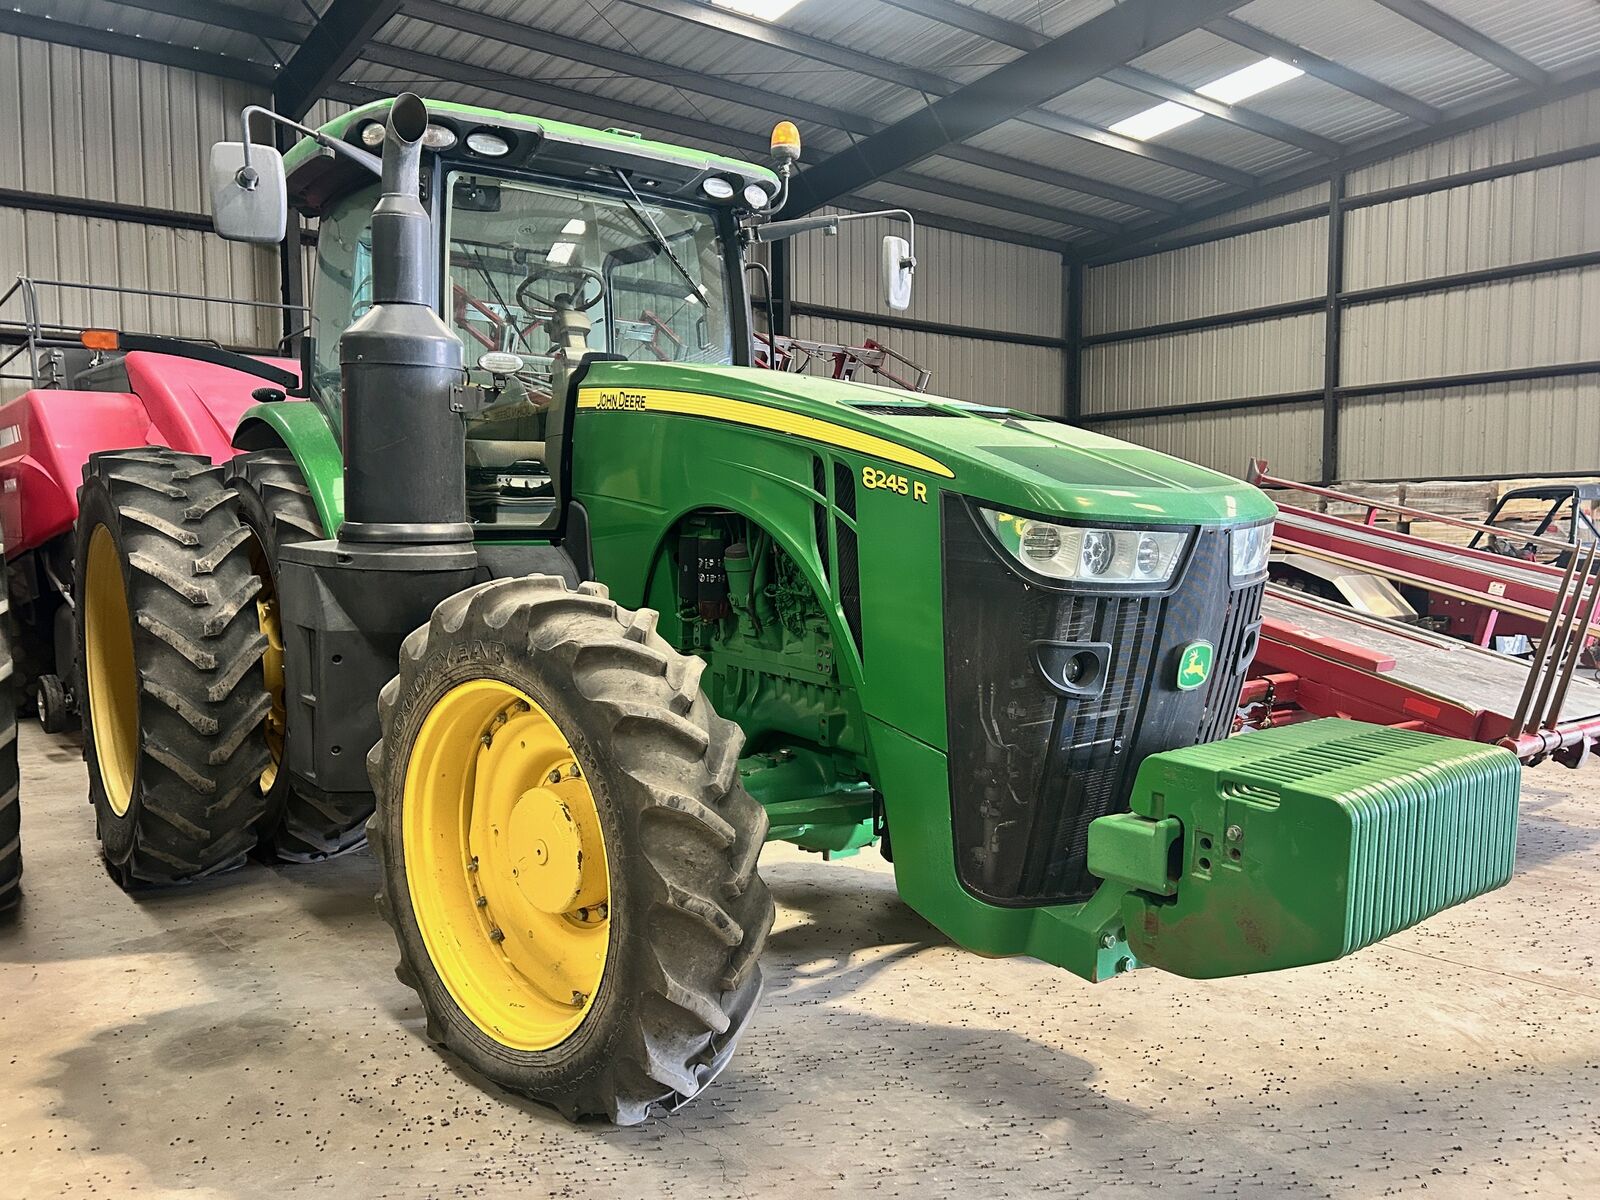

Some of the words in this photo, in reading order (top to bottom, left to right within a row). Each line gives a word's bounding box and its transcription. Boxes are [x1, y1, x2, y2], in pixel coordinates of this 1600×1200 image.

[597, 391, 617, 409] JOHN
[618, 391, 647, 410] DEERE
[862, 466, 909, 496] 8245
[913, 481, 928, 504] R
